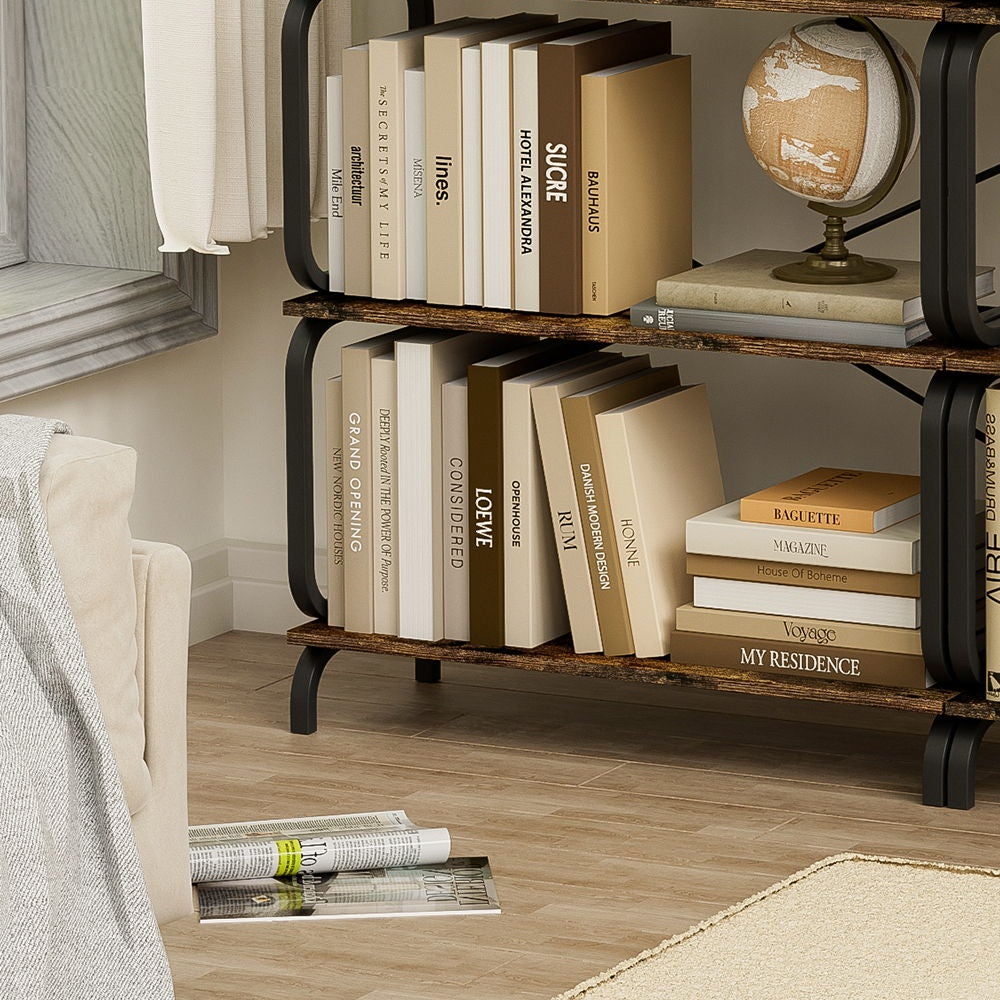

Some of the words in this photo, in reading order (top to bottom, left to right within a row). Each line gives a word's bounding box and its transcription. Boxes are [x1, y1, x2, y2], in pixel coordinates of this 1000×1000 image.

[519, 129, 532, 172] HOTEL
[545, 142, 567, 202] SUCRE
[331, 168, 343, 193] Mile
[350, 146, 364, 207] architectuur
[435, 155, 452, 206] lines.
[331, 195, 344, 218] End
[520, 174, 532, 255] ALEXANDRA
[587, 170, 600, 233] BAUHAUS
[349, 412, 361, 470] GRAND
[579, 463, 596, 503] DANISH
[349, 477, 362, 552] OPENING
[449, 457, 464, 569] CONSIDERED
[475, 487, 493, 548] LOEWE
[511, 480, 521, 547] OPENHOUSE
[557, 510, 578, 551] RUM
[587, 504, 604, 550] MODERN
[774, 508, 840, 526] BAGUETTE
[620, 518, 640, 567] HONNE
[773, 539, 829, 558] MAGAZINE
[595, 551, 611, 590] DESIGN
[757, 564, 789, 578] House
[791, 567, 805, 579] Of
[806, 569, 848, 583] Boheme
[740, 647, 767, 666] MY
[769, 650, 861, 676] RESIDENCE
